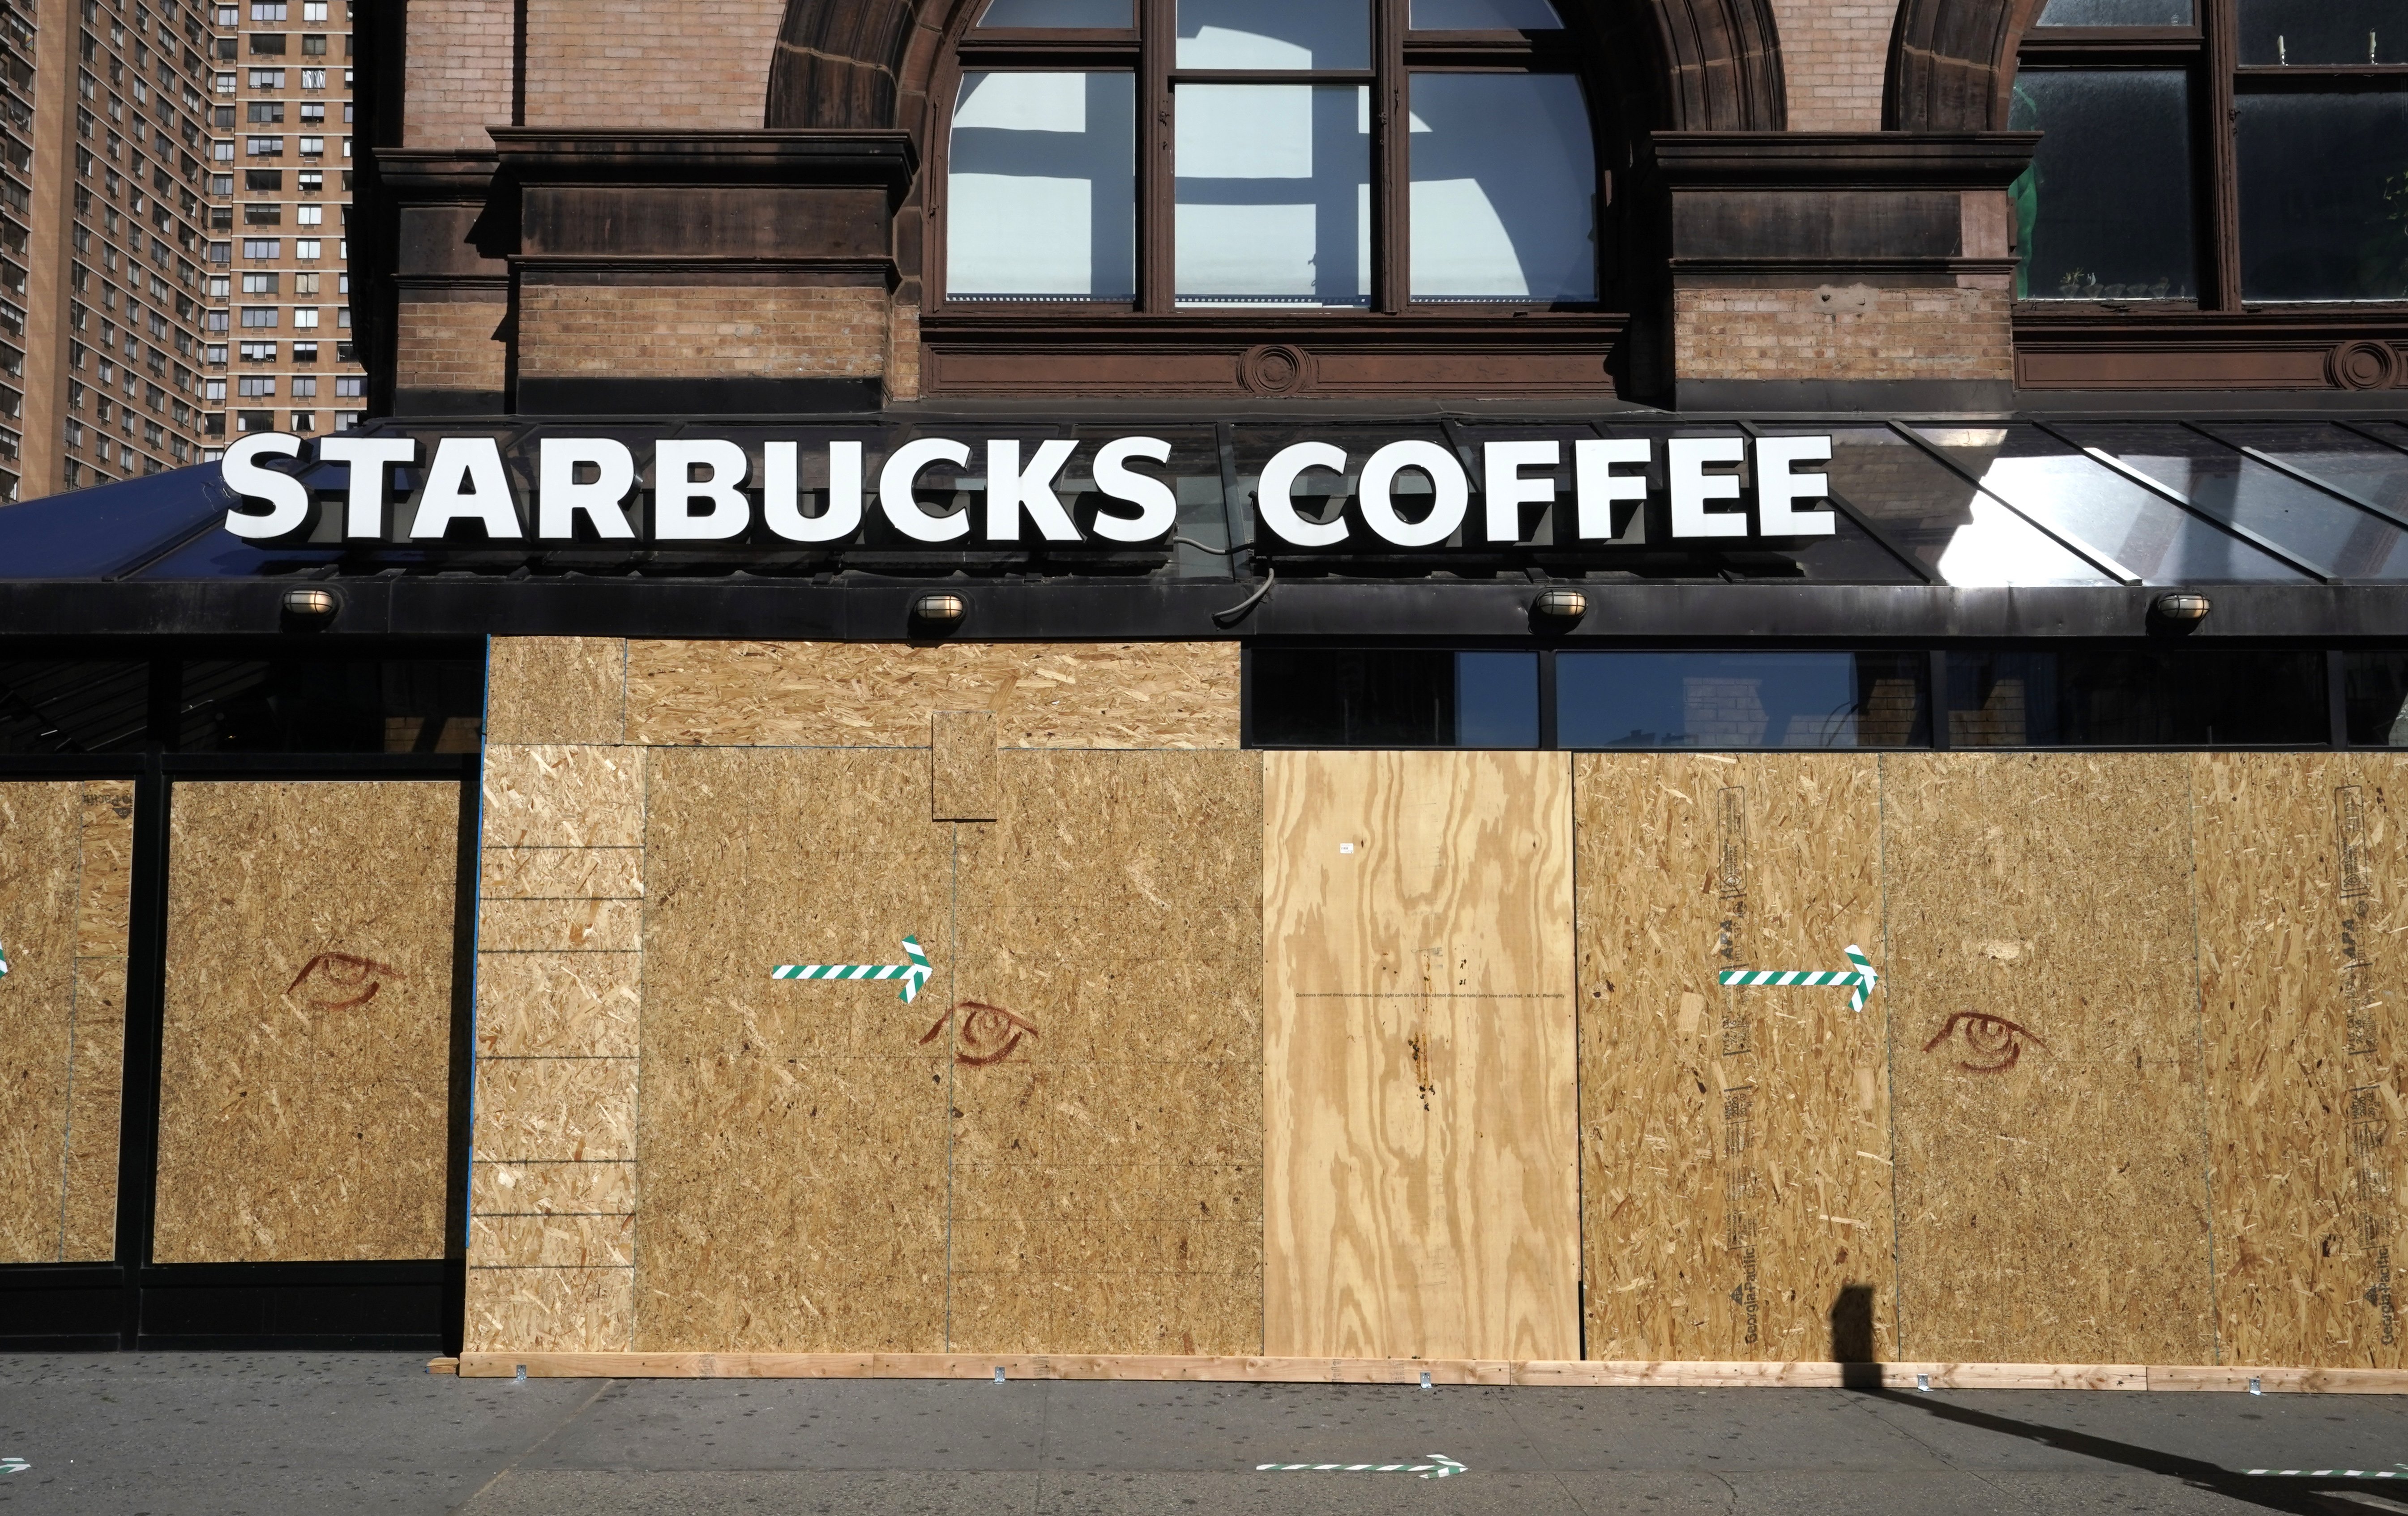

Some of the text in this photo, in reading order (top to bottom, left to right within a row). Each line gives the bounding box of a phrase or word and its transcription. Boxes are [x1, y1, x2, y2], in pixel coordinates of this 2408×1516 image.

[221, 432, 1836, 547] STARBUCKS COFFEE
[1720, 920, 1733, 960] APA
[2342, 919, 2356, 958] APA
